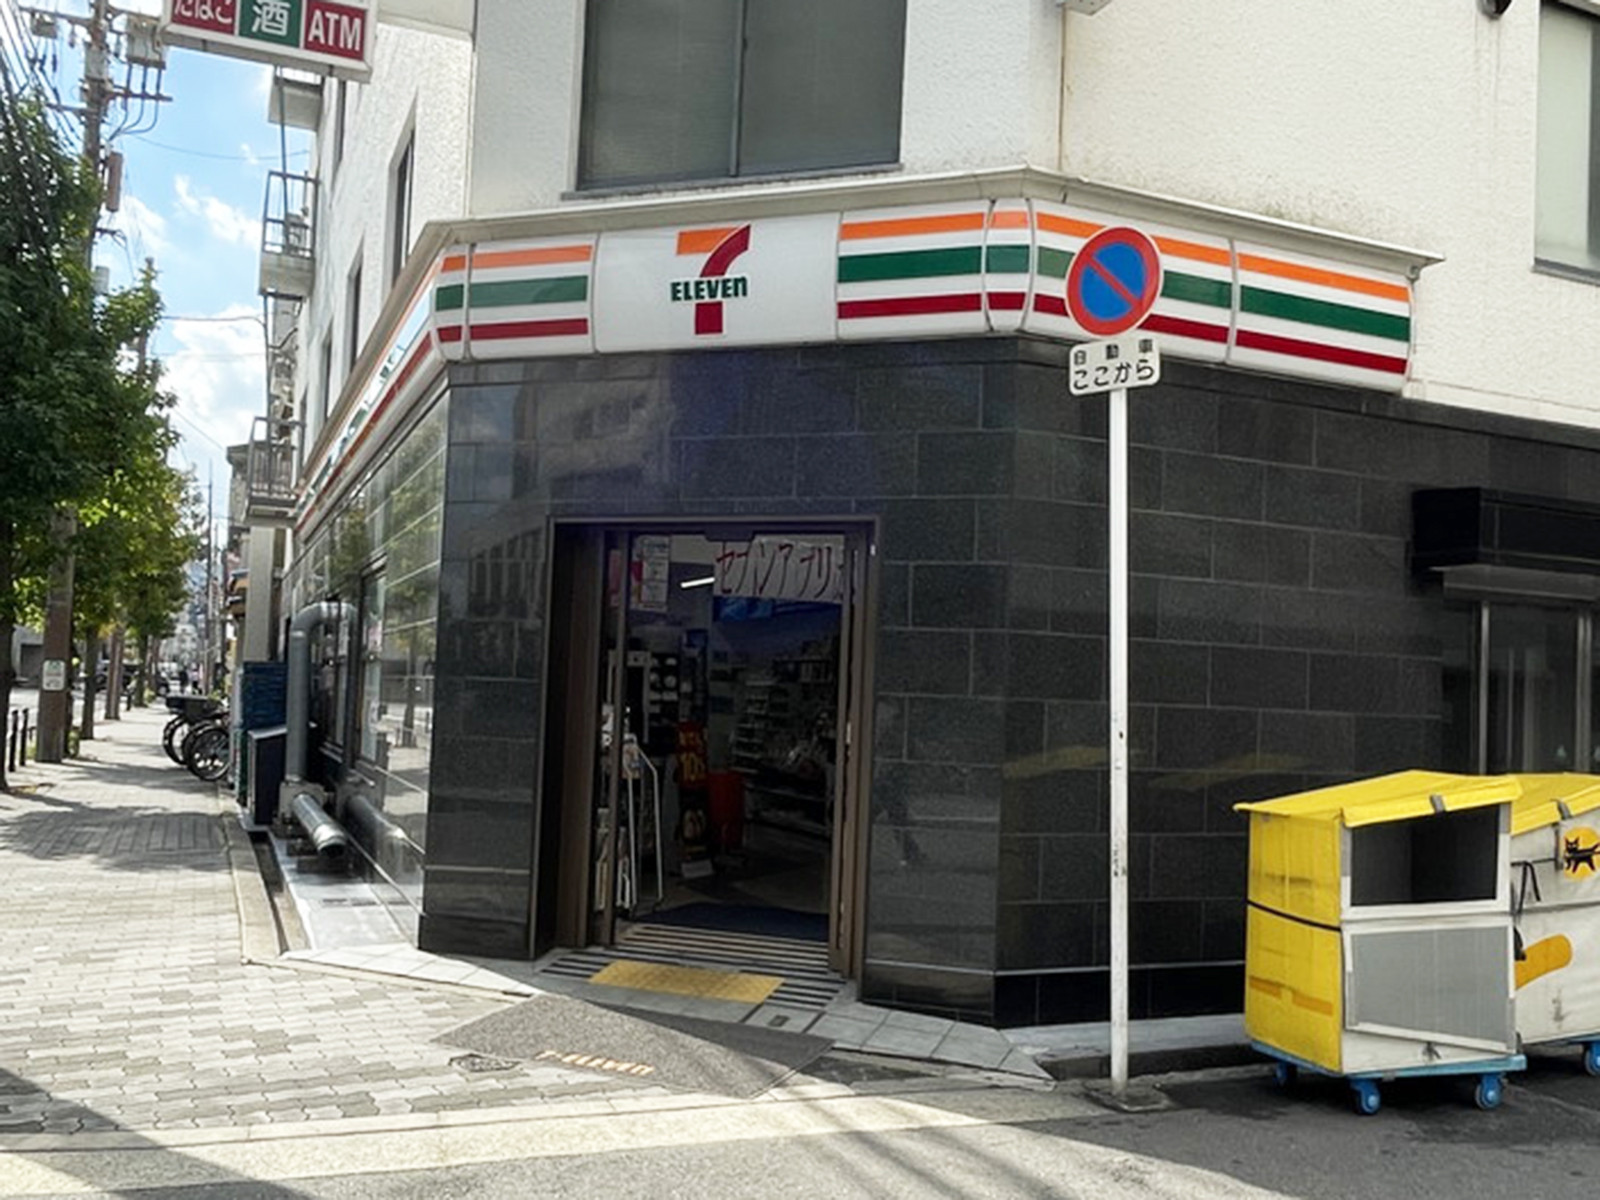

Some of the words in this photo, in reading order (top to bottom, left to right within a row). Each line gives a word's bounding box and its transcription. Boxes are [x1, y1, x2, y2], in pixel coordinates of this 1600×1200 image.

[252, 0, 291, 36] 酒
[308, 9, 362, 51] ATM
[676, 224, 751, 335] 7
[1074, 339, 1153, 365] 自動車
[1074, 359, 1155, 390] ここから
